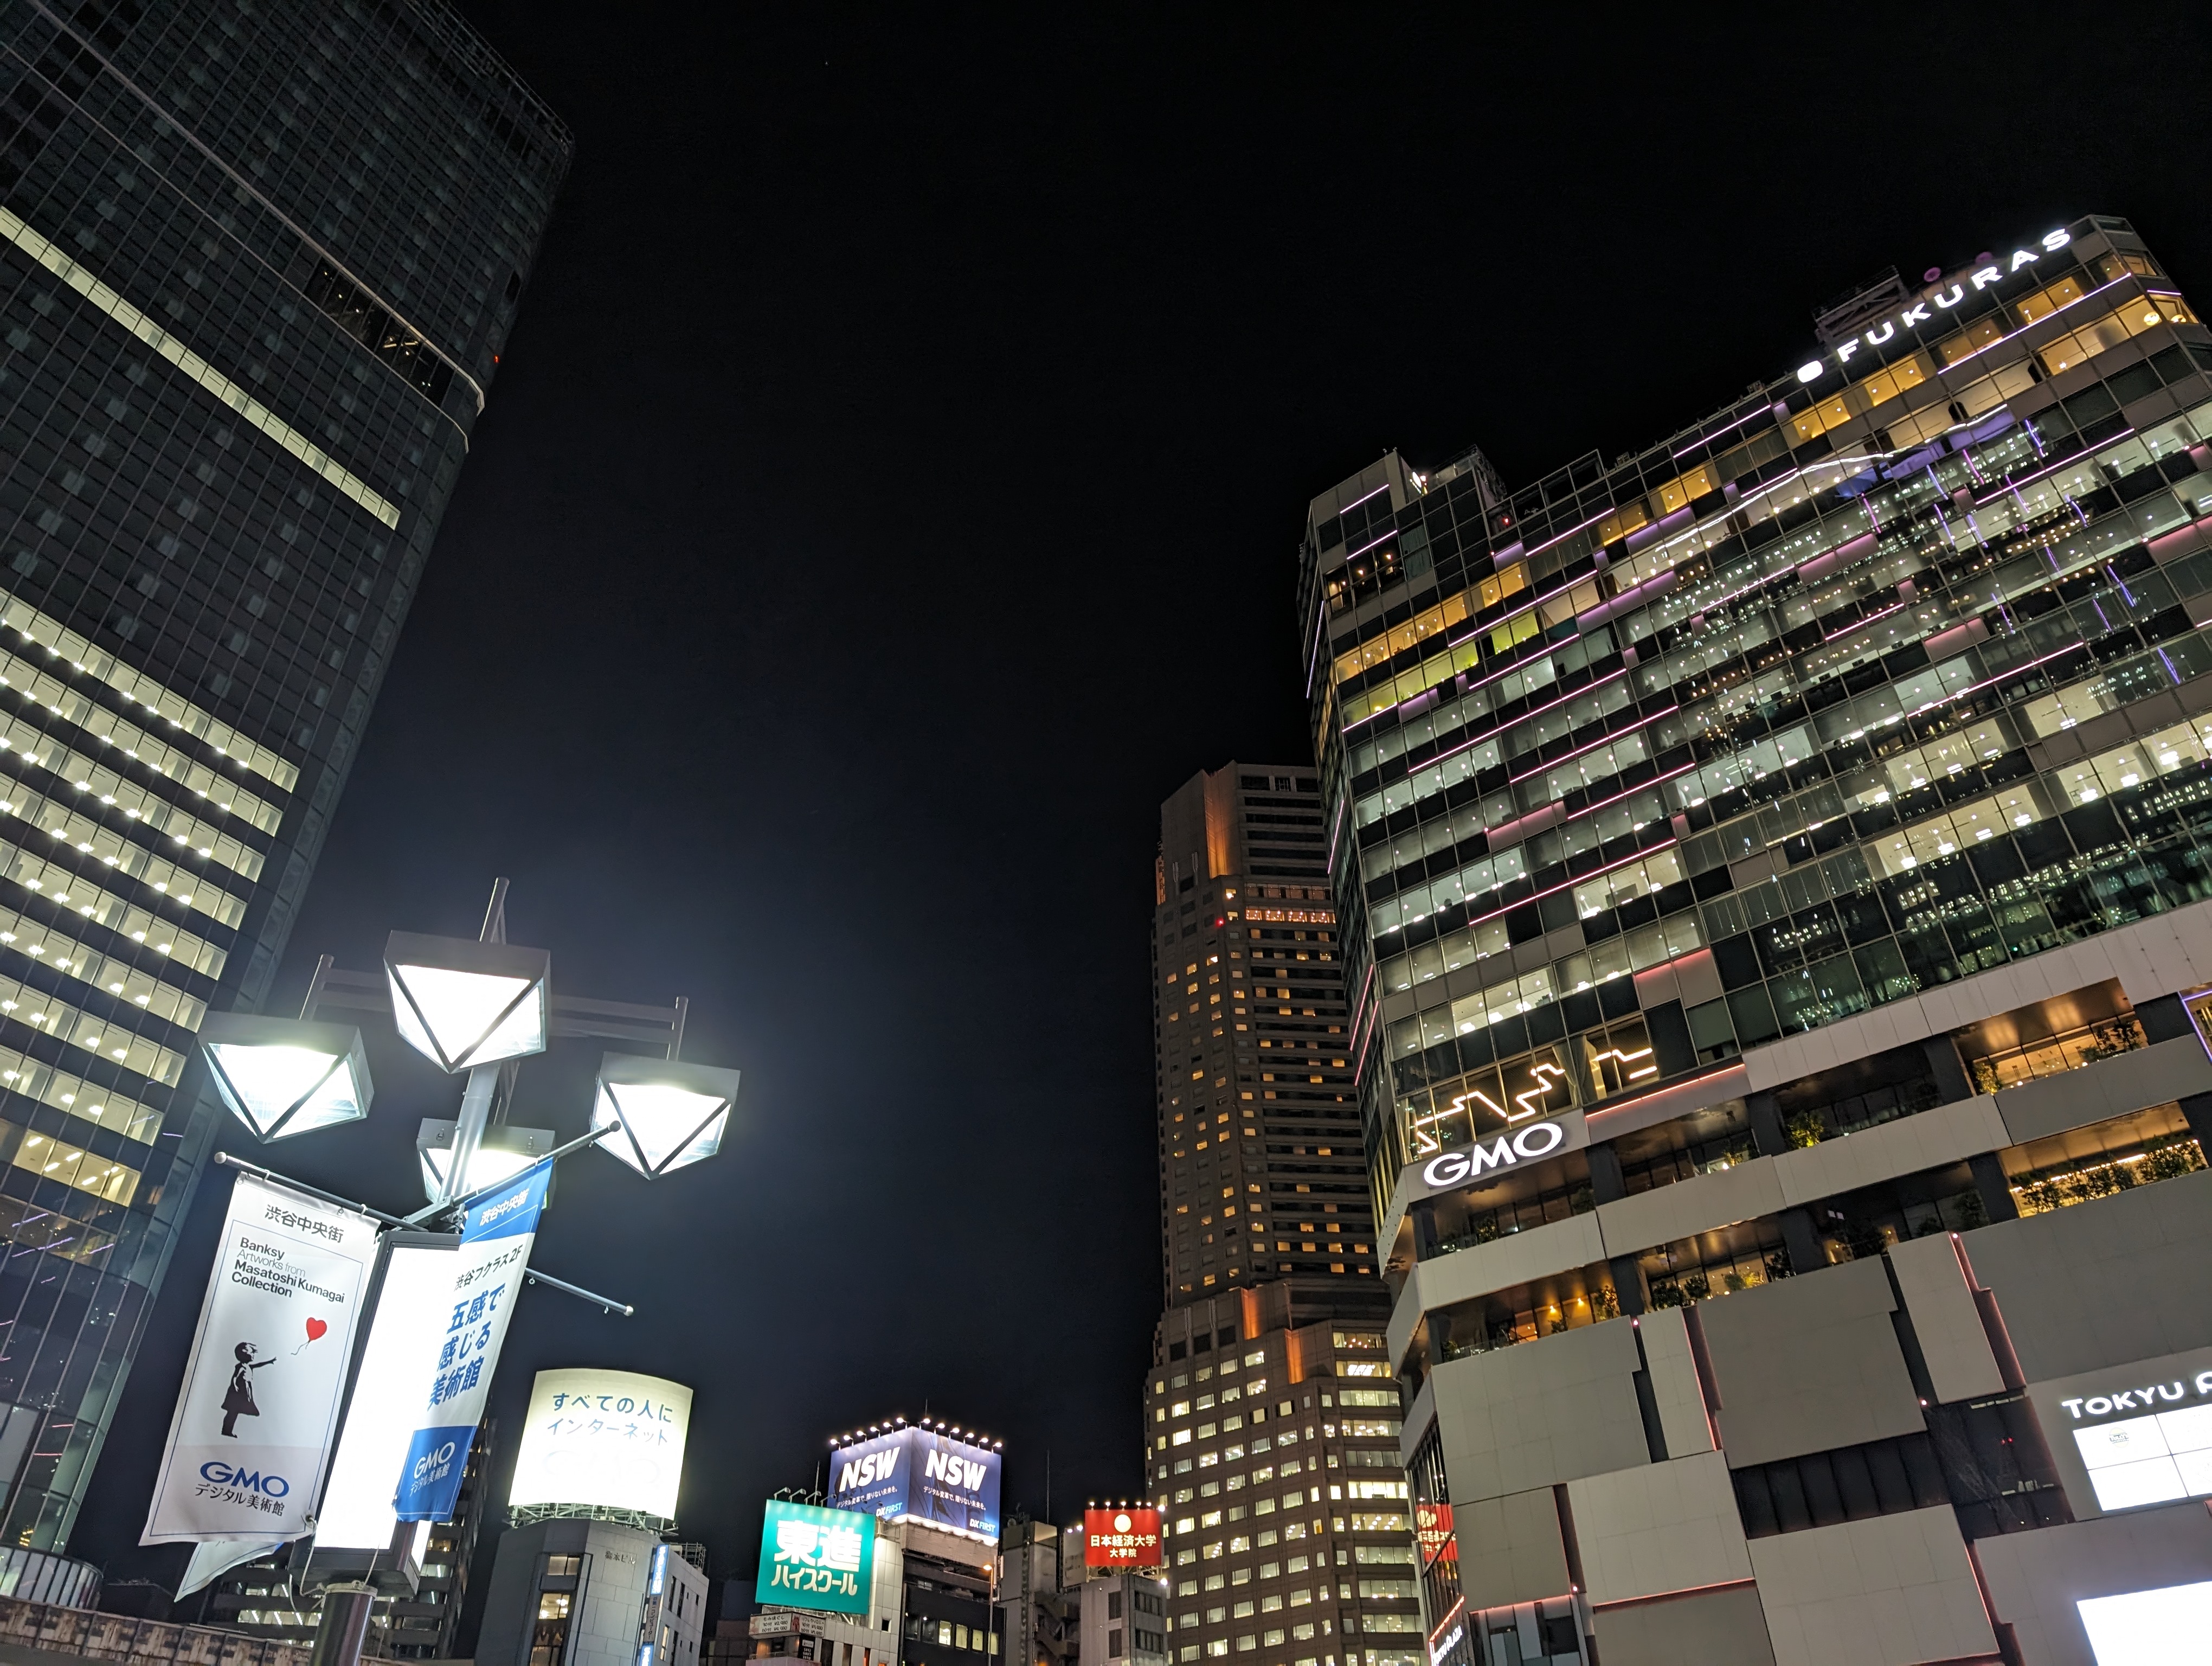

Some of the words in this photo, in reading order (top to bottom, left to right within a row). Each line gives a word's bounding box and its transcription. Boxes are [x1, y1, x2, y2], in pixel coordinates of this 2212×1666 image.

[1837, 228, 2070, 362] FUKURAS
[1424, 1123, 1562, 1186] GMO
[264, 1204, 344, 1243] 渋谷中央街
[479, 1188, 529, 1227] 渋谷中央街
[237, 1249, 283, 1270] Artworks
[285, 1263, 306, 1278] from
[240, 1236, 285, 1260] Banksy
[232, 1272, 292, 1298] Collection
[234, 1259, 297, 1287] Masatoshi
[298, 1278, 345, 1303] Kumagai
[446, 1283, 506, 1335] 五感で
[436, 1321, 491, 1372] 感じる
[427, 1355, 485, 1412] 美術館
[2061, 1381, 2184, 1419] TOKYU
[552, 1393, 673, 1423] すべての人に
[547, 1418, 668, 1446] インターネット
[414, 1441, 455, 1479] GMO
[839, 1446, 901, 1492] NSW
[924, 1449, 987, 1491] NSW
[200, 1461, 290, 1498] GMO
[409, 1462, 451, 1497] デジタル美術館
[195, 1483, 285, 1517] デジタル美術館
[774, 1520, 862, 1573] 東進
[1090, 1534, 1157, 1547] 日本経済大学
[1109, 1548, 1137, 1558] 大学院
[771, 1564, 858, 1596] ハイスクール
